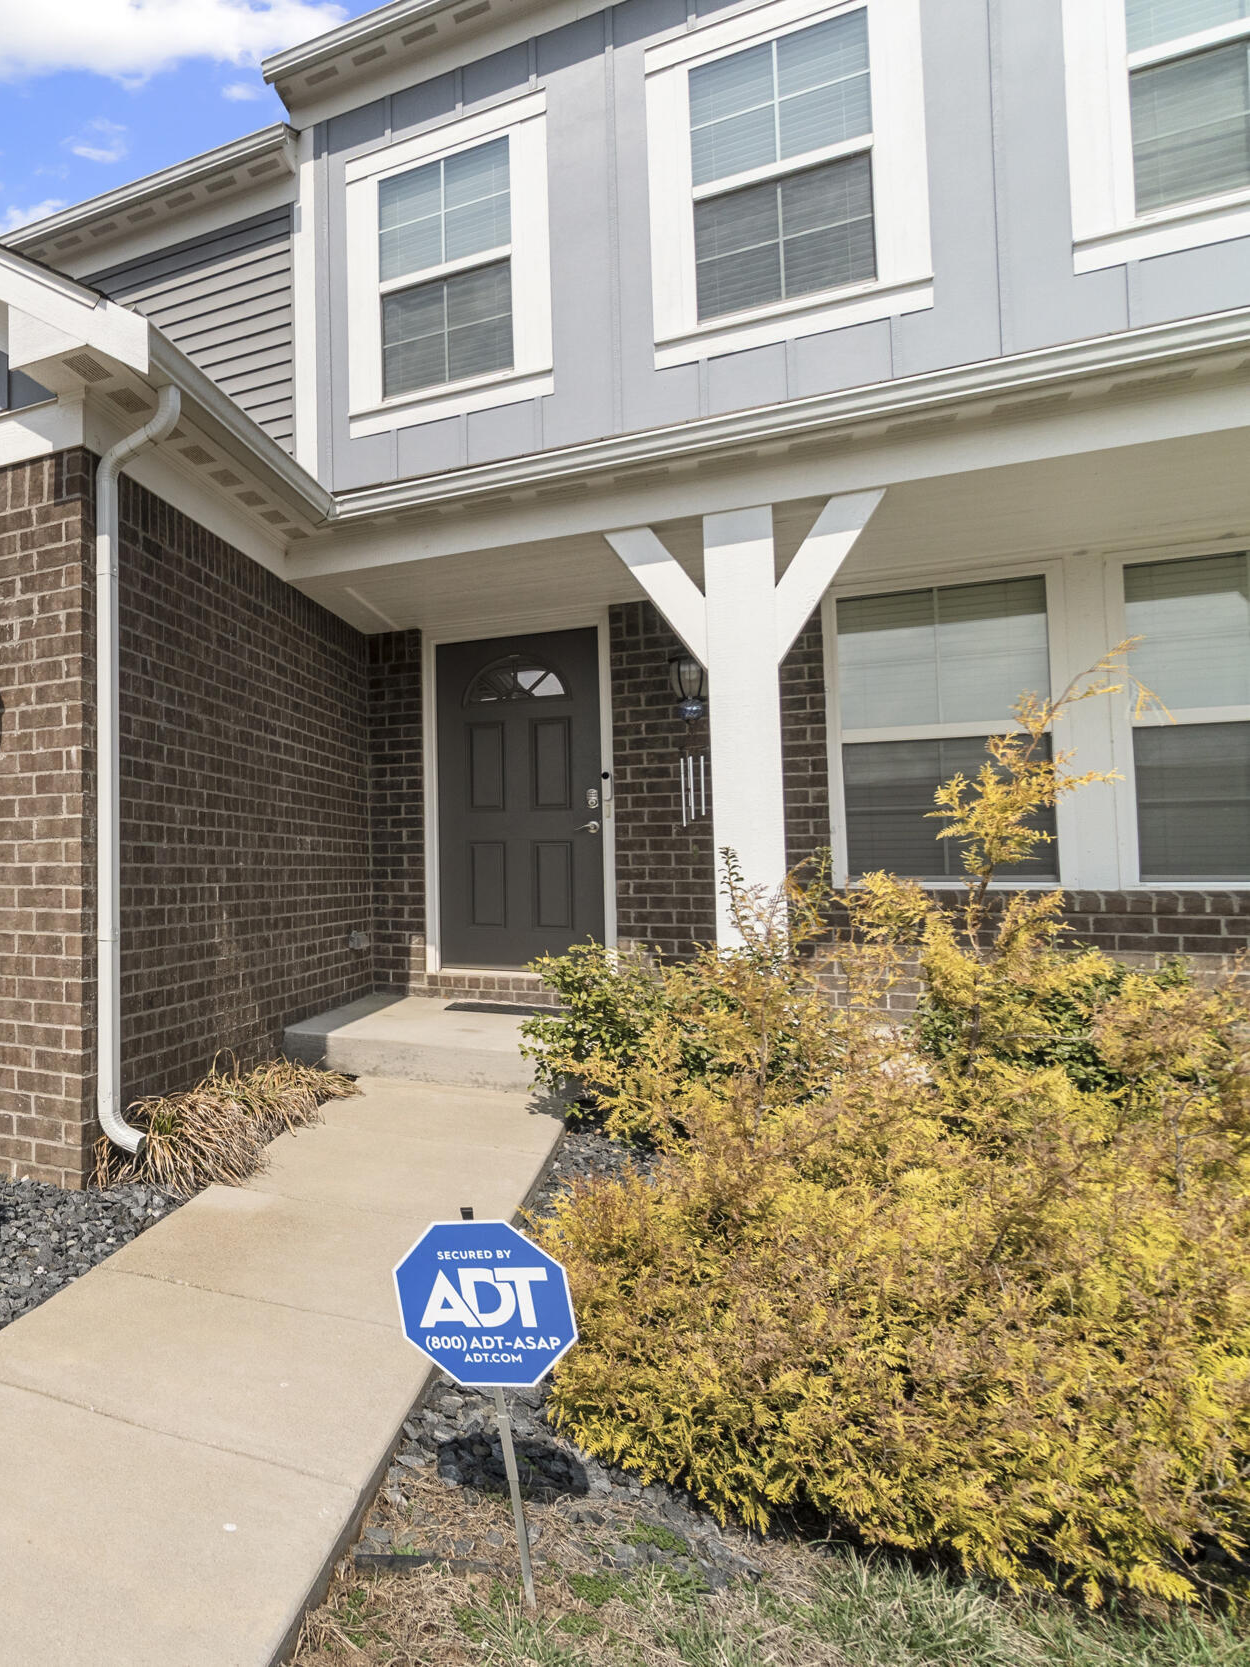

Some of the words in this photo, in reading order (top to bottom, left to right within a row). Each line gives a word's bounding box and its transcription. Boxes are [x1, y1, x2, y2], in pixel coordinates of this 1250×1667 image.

[436, 1250, 493, 1261] SECURED
[496, 1249, 511, 1259] BY
[419, 1266, 548, 1328] ADT
[425, 1335, 467, 1351] (800)
[469, 1335, 561, 1351] ADT-ASAP
[464, 1352, 523, 1364] ADT.COM
